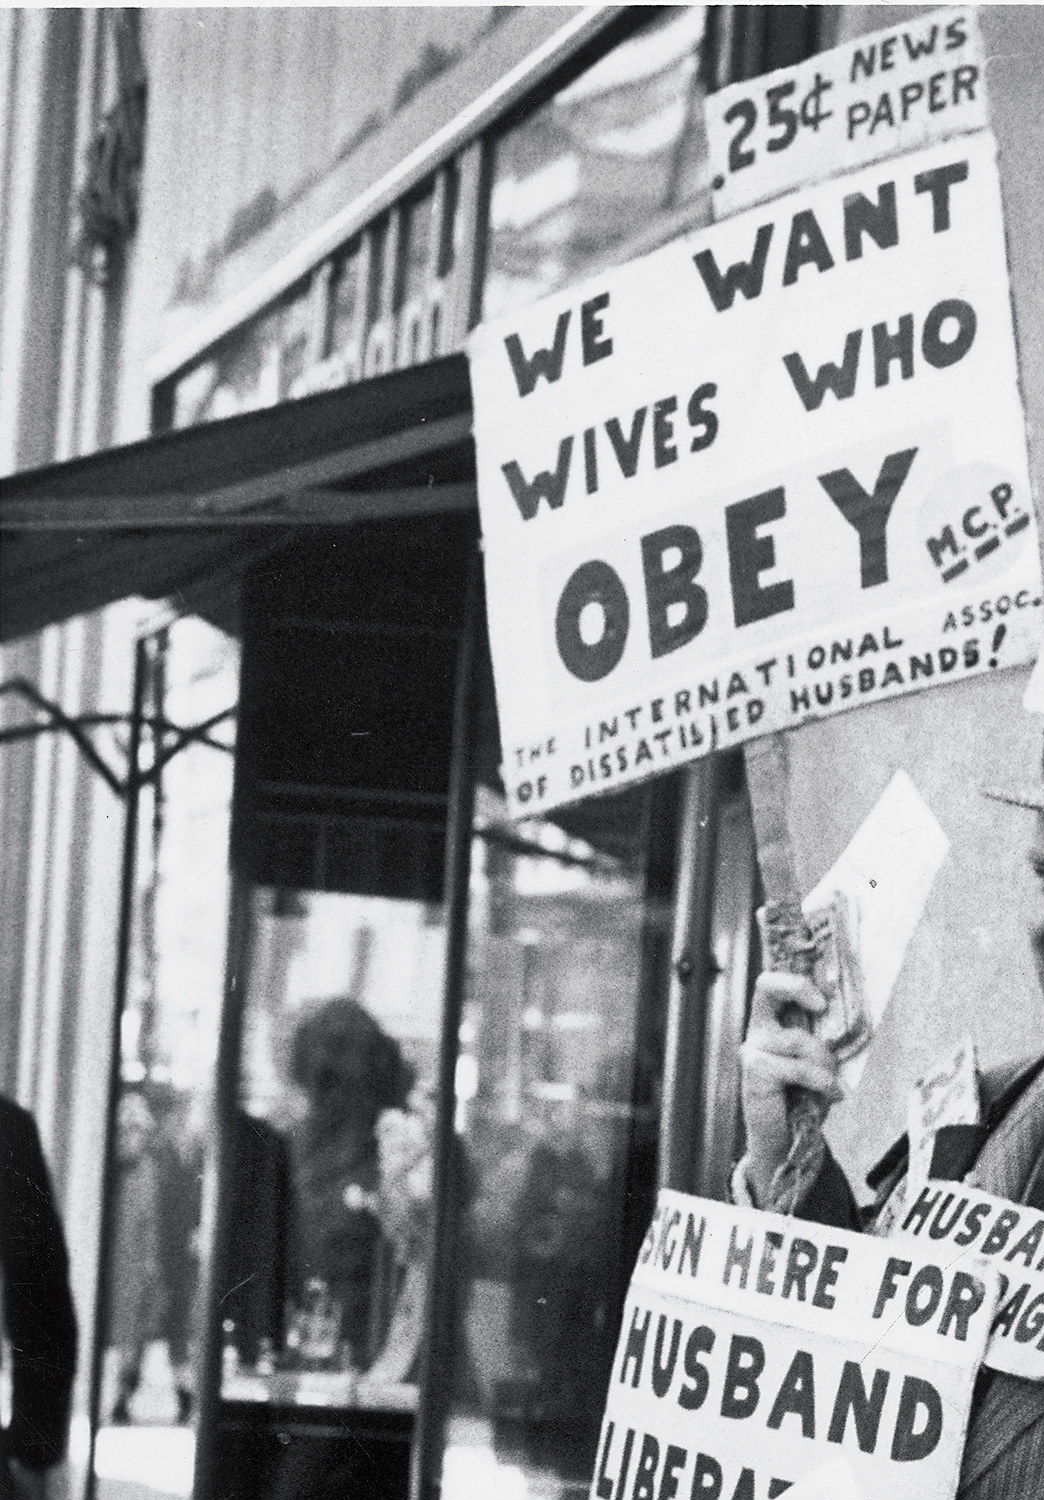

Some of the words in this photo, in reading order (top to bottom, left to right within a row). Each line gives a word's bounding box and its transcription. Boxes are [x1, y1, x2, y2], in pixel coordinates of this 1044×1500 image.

[847, 64, 979, 139] PAPER
[850, 17, 967, 82] NEWS
[504, 293, 613, 398] WE
[693, 161, 968, 311] WANT
[501, 382, 719, 521] WIVES
[782, 299, 977, 412] WHO
[555, 447, 919, 682] OBEY
[515, 736, 556, 766] THE
[584, 627, 902, 751] INTERNATIONAL
[942, 590, 1041, 632] ASSOC.
[516, 775, 547, 804] OF
[790, 624, 1006, 714] HUSBANDS!
[723, 1225, 848, 1310] HERE
[872, 1256, 986, 1342] FOR
[620, 1306, 944, 1462] HUSBAND
